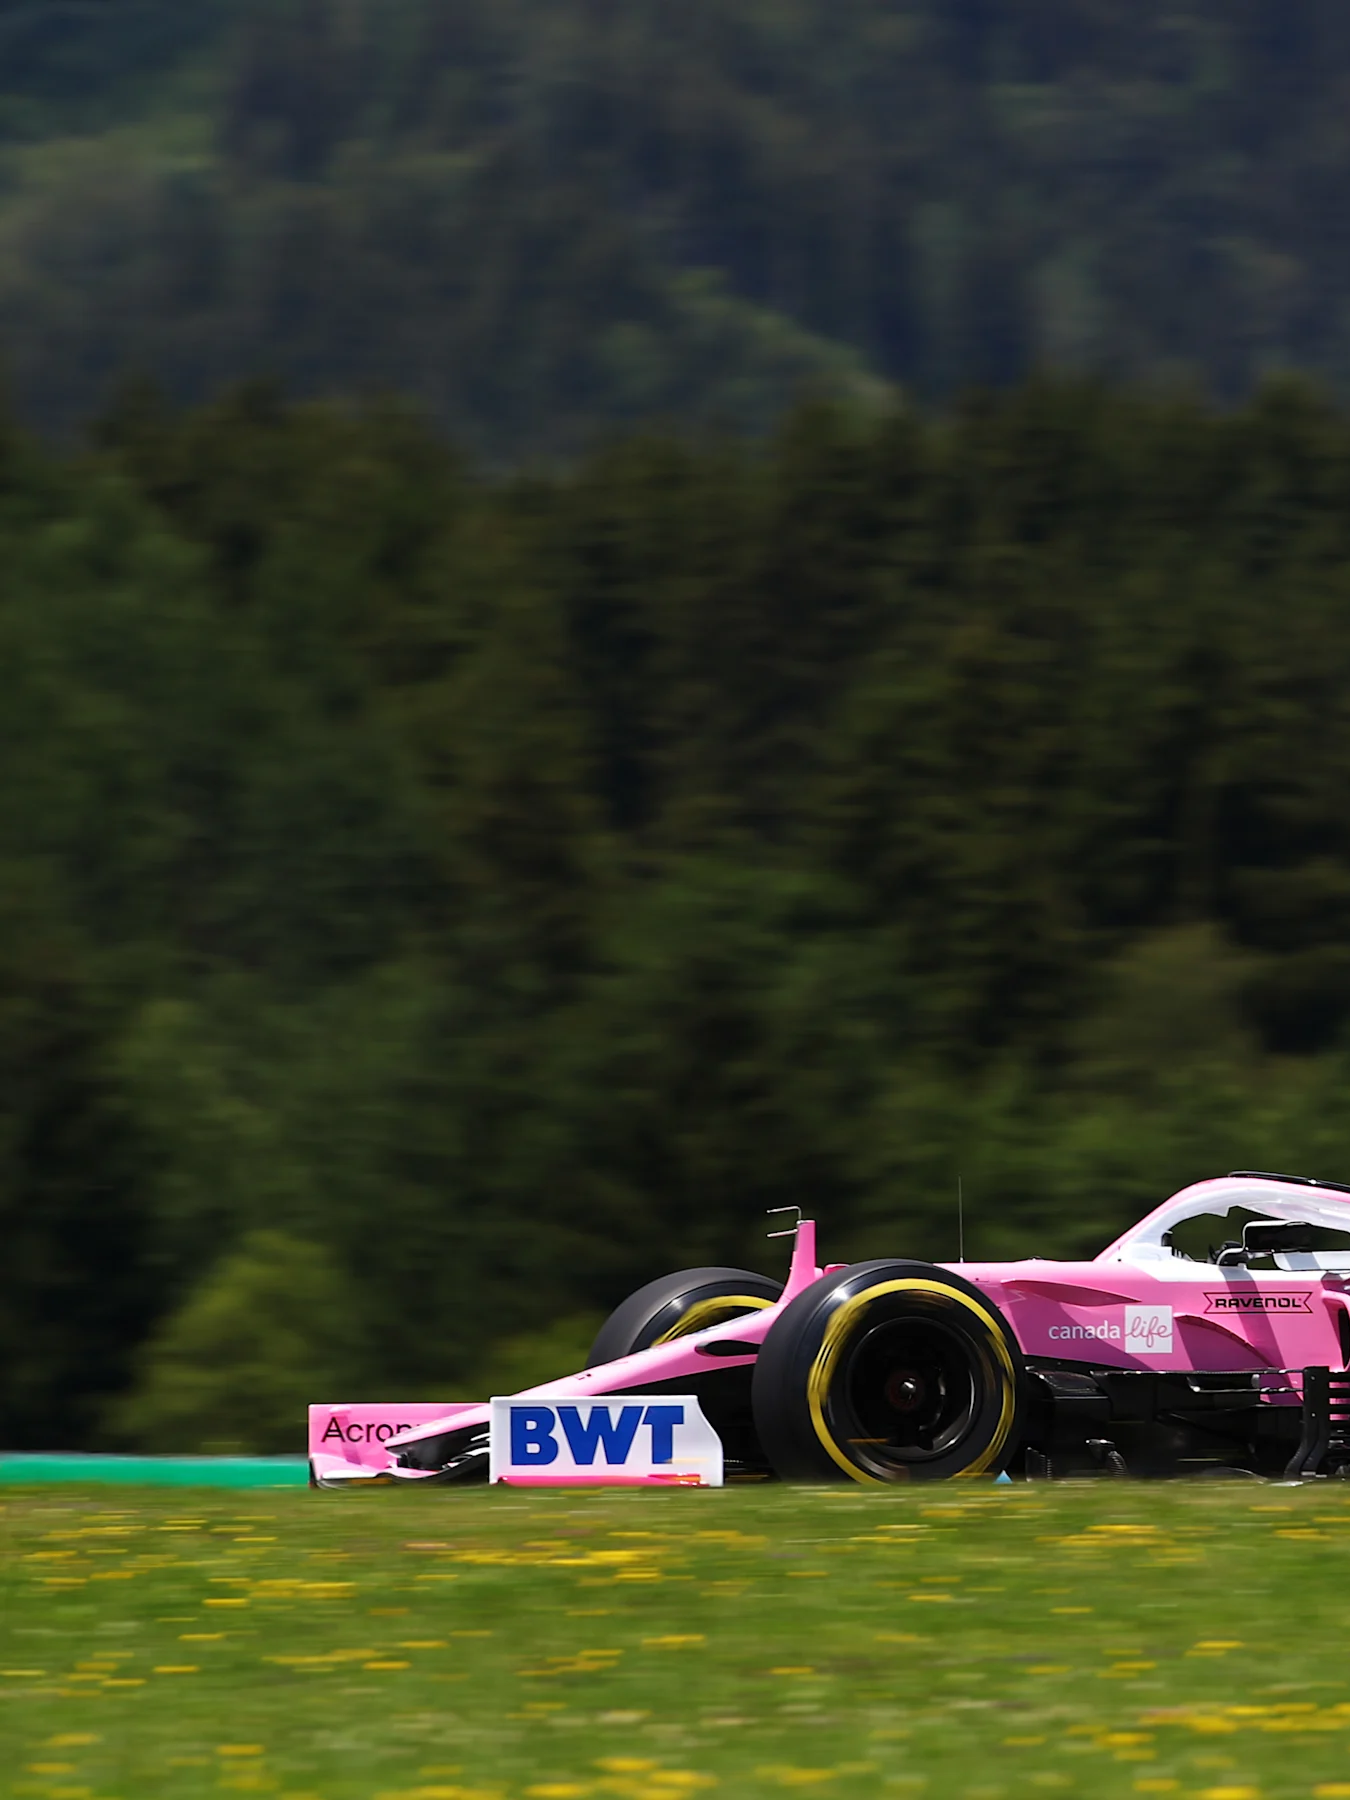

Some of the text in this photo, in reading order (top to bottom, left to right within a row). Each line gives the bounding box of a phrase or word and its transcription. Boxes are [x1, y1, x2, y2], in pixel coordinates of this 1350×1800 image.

[1215, 1297, 1302, 1308] RAVENOL
[1048, 1316, 1173, 1348] canada life
[510, 1405, 684, 1465] BWT
